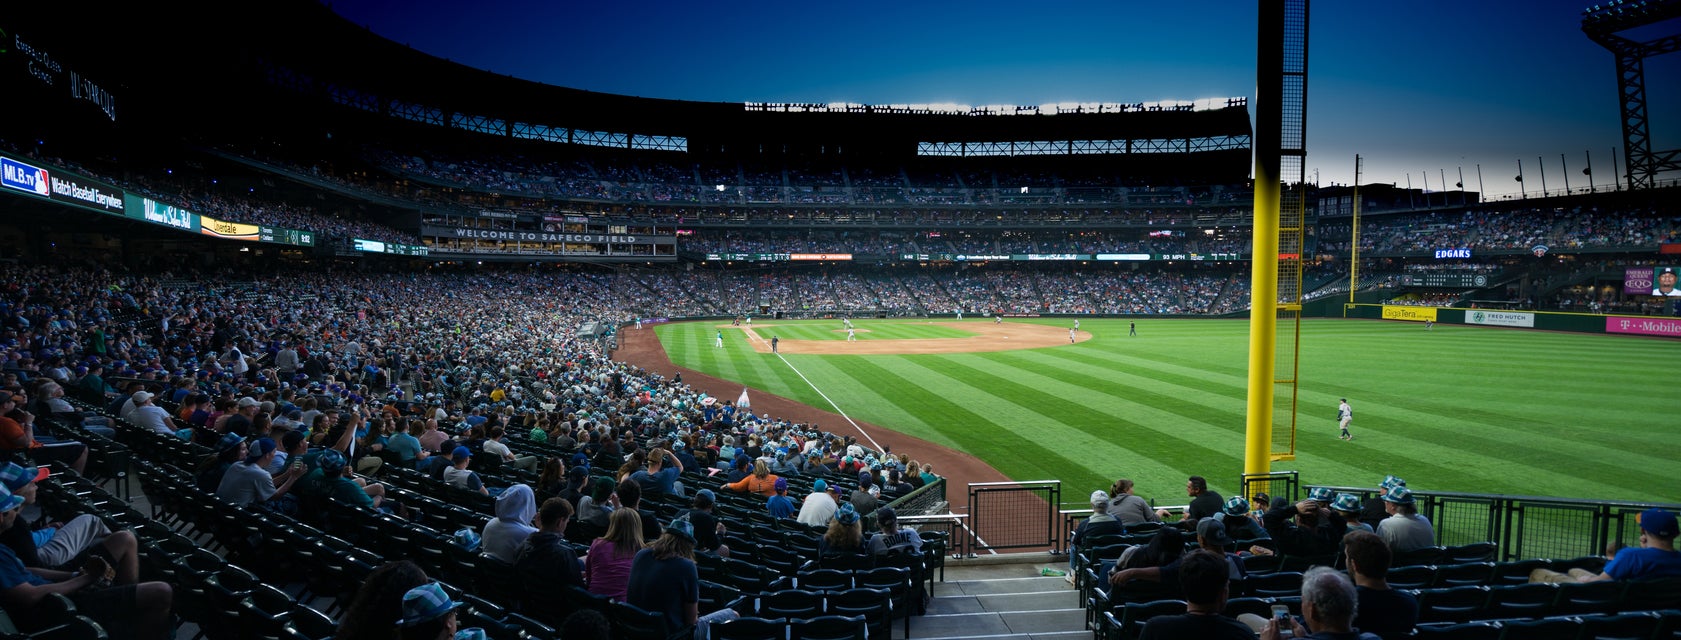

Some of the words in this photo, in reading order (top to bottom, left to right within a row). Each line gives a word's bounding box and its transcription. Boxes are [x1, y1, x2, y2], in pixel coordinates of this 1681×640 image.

[51, 176, 72, 197] Watch
[71, 182, 95, 202] Baseball
[95, 189, 124, 209] Everywhere.
[456, 228, 514, 240] WELCOME
[520, 232, 536, 240] TO
[541, 233, 592, 242] SAFECO
[598, 235, 636, 243] FIELD
[1629, 279, 1650, 289] EQC
[1384, 308, 1416, 318] GigaTera
[883, 533, 911, 548] BOONE
